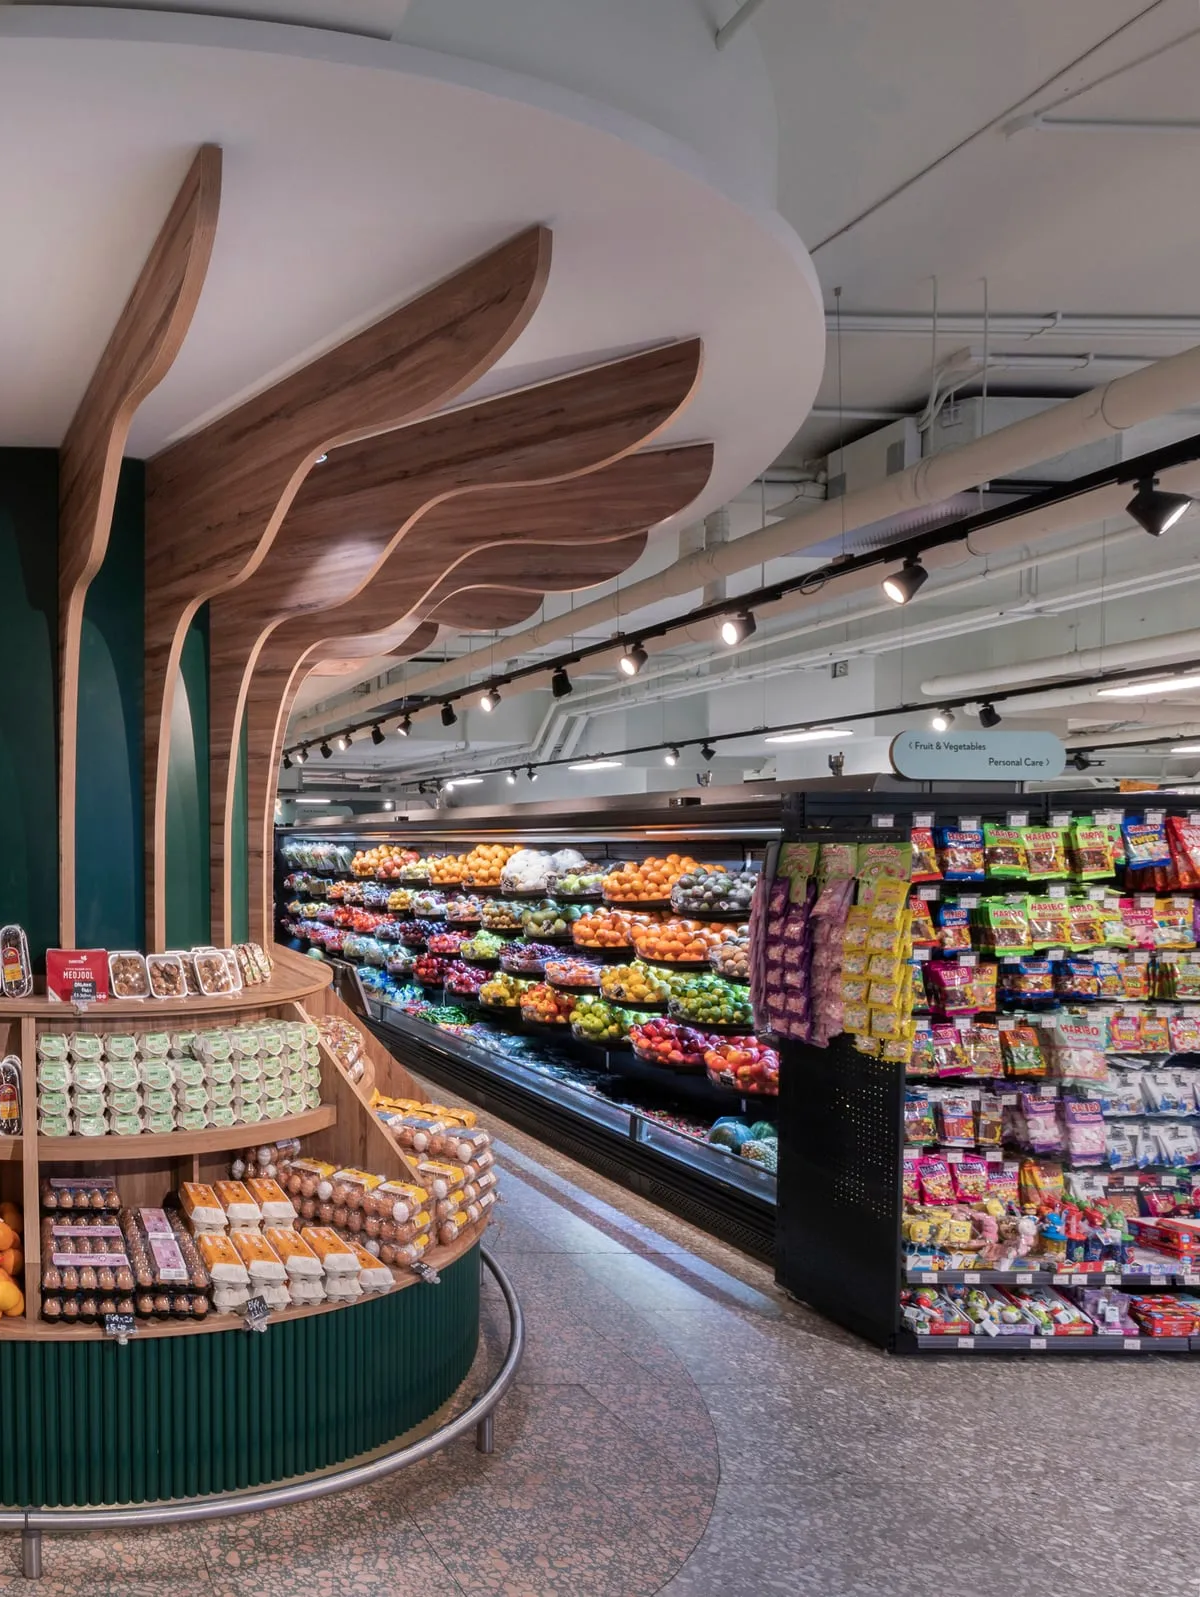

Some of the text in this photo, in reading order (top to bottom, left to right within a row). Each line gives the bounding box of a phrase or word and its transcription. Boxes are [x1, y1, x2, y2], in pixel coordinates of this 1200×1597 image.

[914, 741, 987, 752] Fruit & Vegetables
[988, 757, 1044, 767] Personal Care
[1025, 831, 1059, 841] HARIBO
[1031, 903, 1065, 911] HARIBO
[63, 970, 94, 980] MEDJOOL
[1059, 1024, 1100, 1036] HARIBO
[1070, 1102, 1100, 1113] HARIBO
